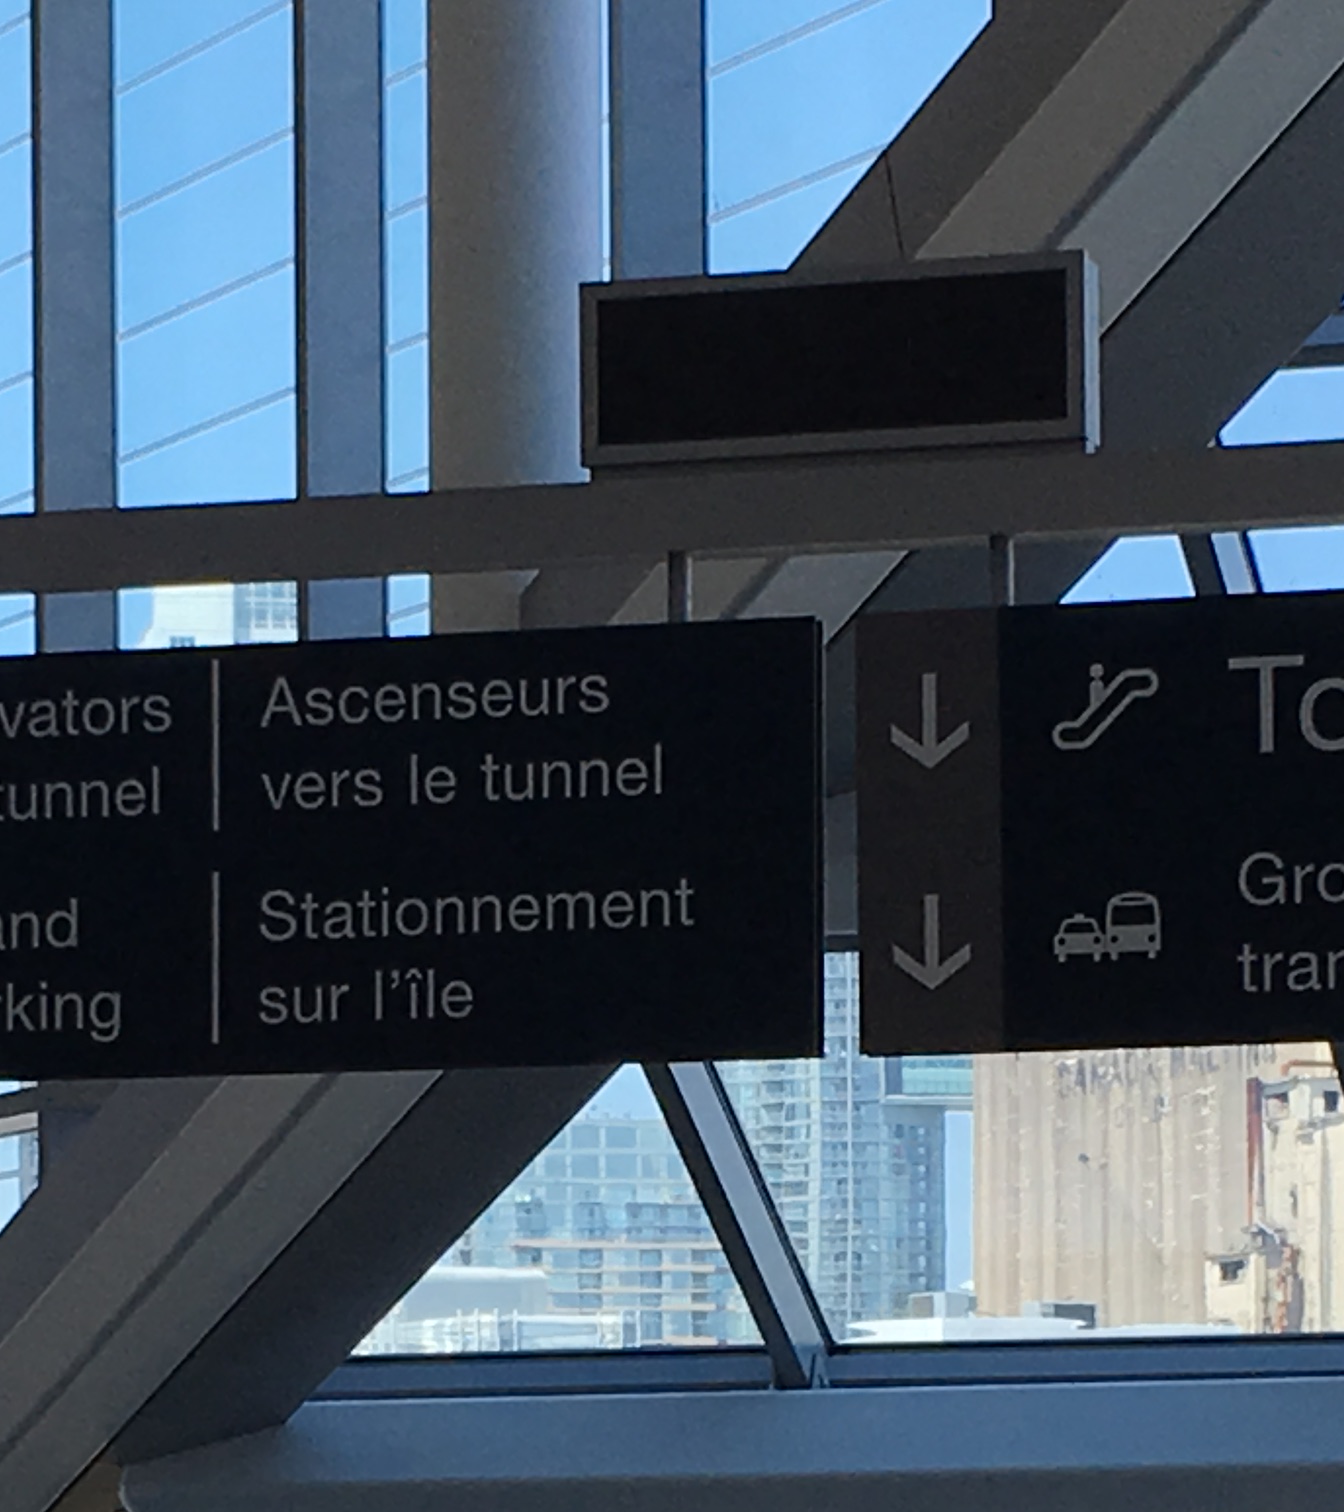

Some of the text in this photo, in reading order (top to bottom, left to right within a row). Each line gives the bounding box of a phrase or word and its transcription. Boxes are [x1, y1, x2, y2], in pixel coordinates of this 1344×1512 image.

[260, 674, 610, 729] Ascenseurs
[260, 742, 663, 811] vers le tunnel
[259, 877, 695, 942] Stationnement
[258, 967, 474, 1025] sur l'île
